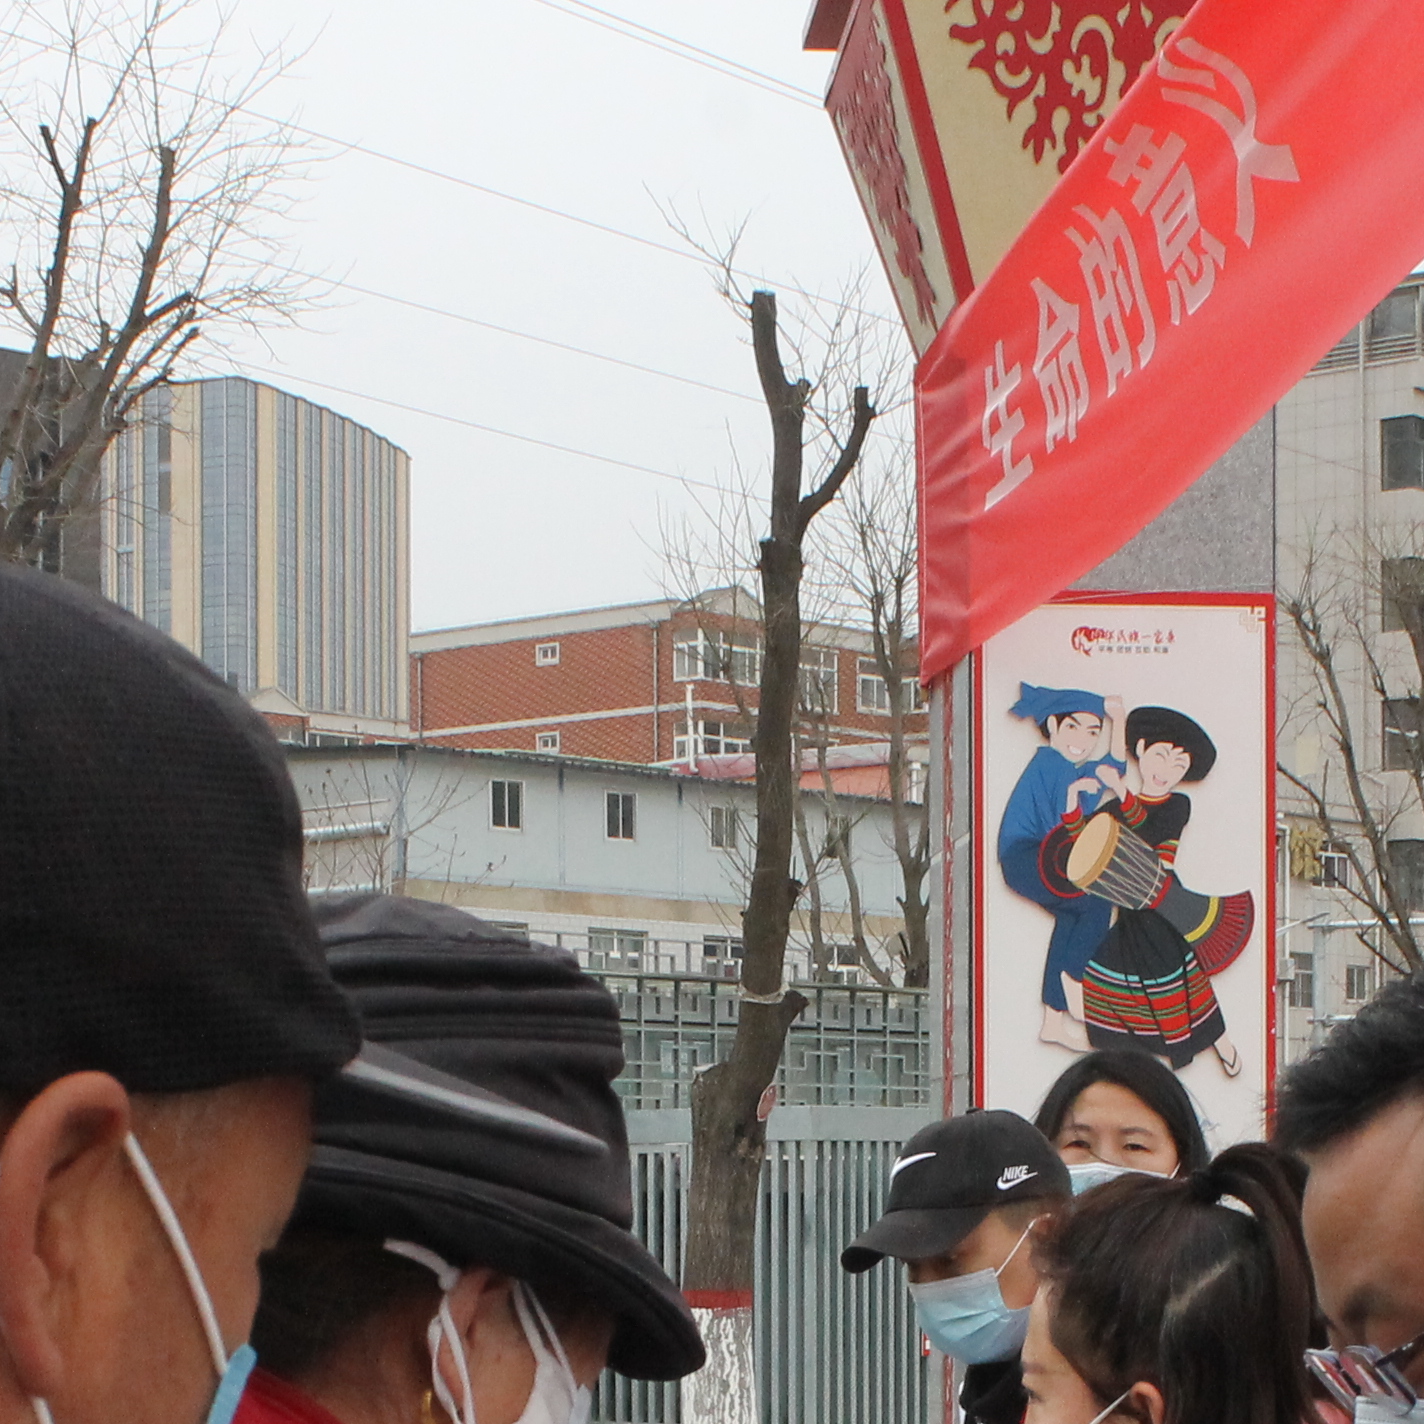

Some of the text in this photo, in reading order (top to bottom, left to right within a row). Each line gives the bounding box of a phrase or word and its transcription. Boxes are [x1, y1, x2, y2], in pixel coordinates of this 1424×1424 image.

[981, 37, 1300, 512] 生命的意义
[1003, 1165, 1029, 1181] NIKE
